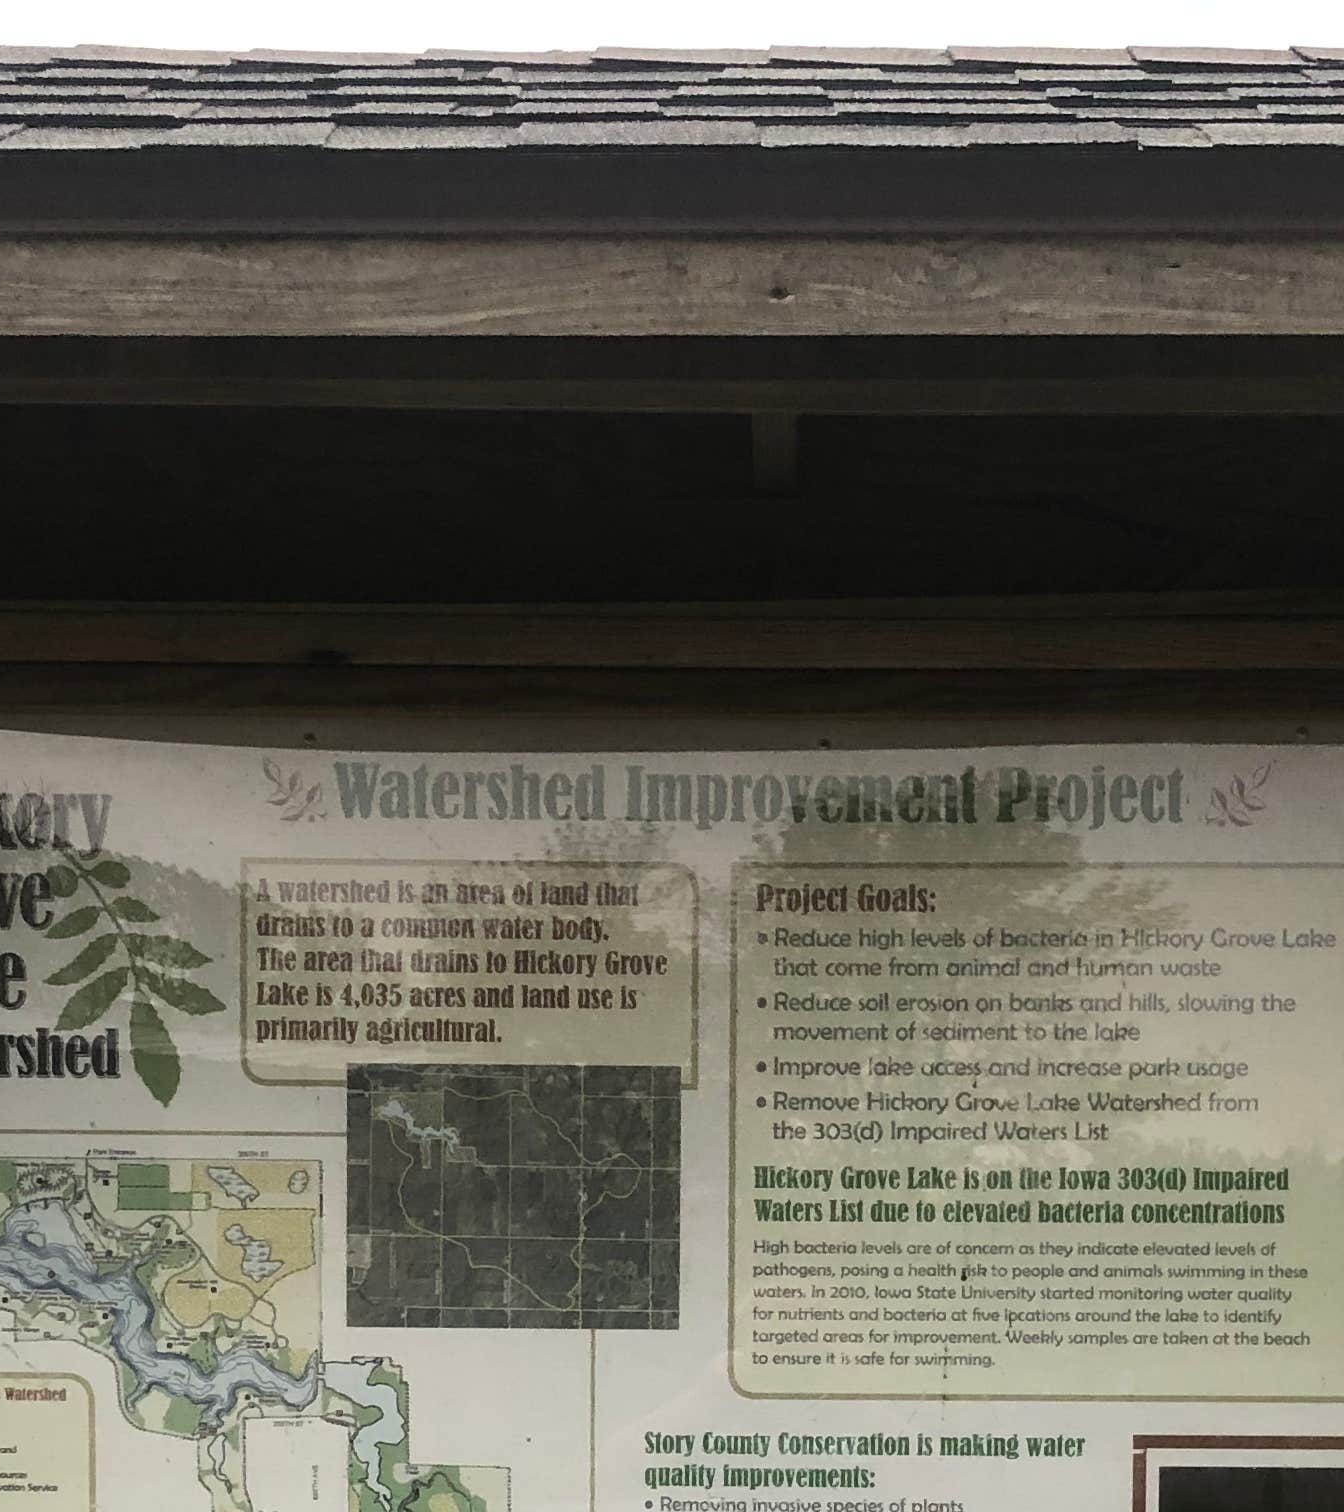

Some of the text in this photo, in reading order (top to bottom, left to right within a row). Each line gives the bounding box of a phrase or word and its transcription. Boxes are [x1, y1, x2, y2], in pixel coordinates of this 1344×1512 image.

[333, 761, 1184, 831] Watershed Improvement Project
[756, 884, 936, 915] Project Goals:
[256, 913, 608, 943] drains to a common water body.
[256, 947, 666, 976] The area that drains to Hickory Grove
[257, 983, 636, 1009] Lake is 4,035 acres and land use is
[774, 993, 1295, 1014] Reduce soil erosion on banks and hills, slowing the
[255, 1017, 501, 1044] primarily agricultural.
[773, 1022, 1139, 1041] movement of sediment to the lake
[773, 1092, 1258, 1114] Remove Hickory Grove Lake Watershed from
[773, 1121, 1108, 1143] the 303(d) Impaired Waters List
[755, 1167, 1287, 1193] Hickory Grove Lake is on the Iowa 303(d) Impaired
[755, 1199, 1284, 1223] Waters List due to elevated bacteria concentrations
[812, 1285, 825, 1297] In
[830, 1286, 868, 1299] 2010,
[875, 1285, 911, 1298] Iowa
[917, 1285, 955, 1299] State
[961, 1285, 1035, 1301] University
[1040, 1286, 1093, 1299] started
[1099, 1287, 1182, 1302] monitoring
[1187, 1288, 1231, 1300] water
[1237, 1287, 1291, 1303] quality
[644, 1431, 1085, 1459] Story County Conservation is making water
[644, 1464, 875, 1490] quality improvements:
[753, 1498, 820, 1512] invasive
[889, 1497, 904, 1512] of
